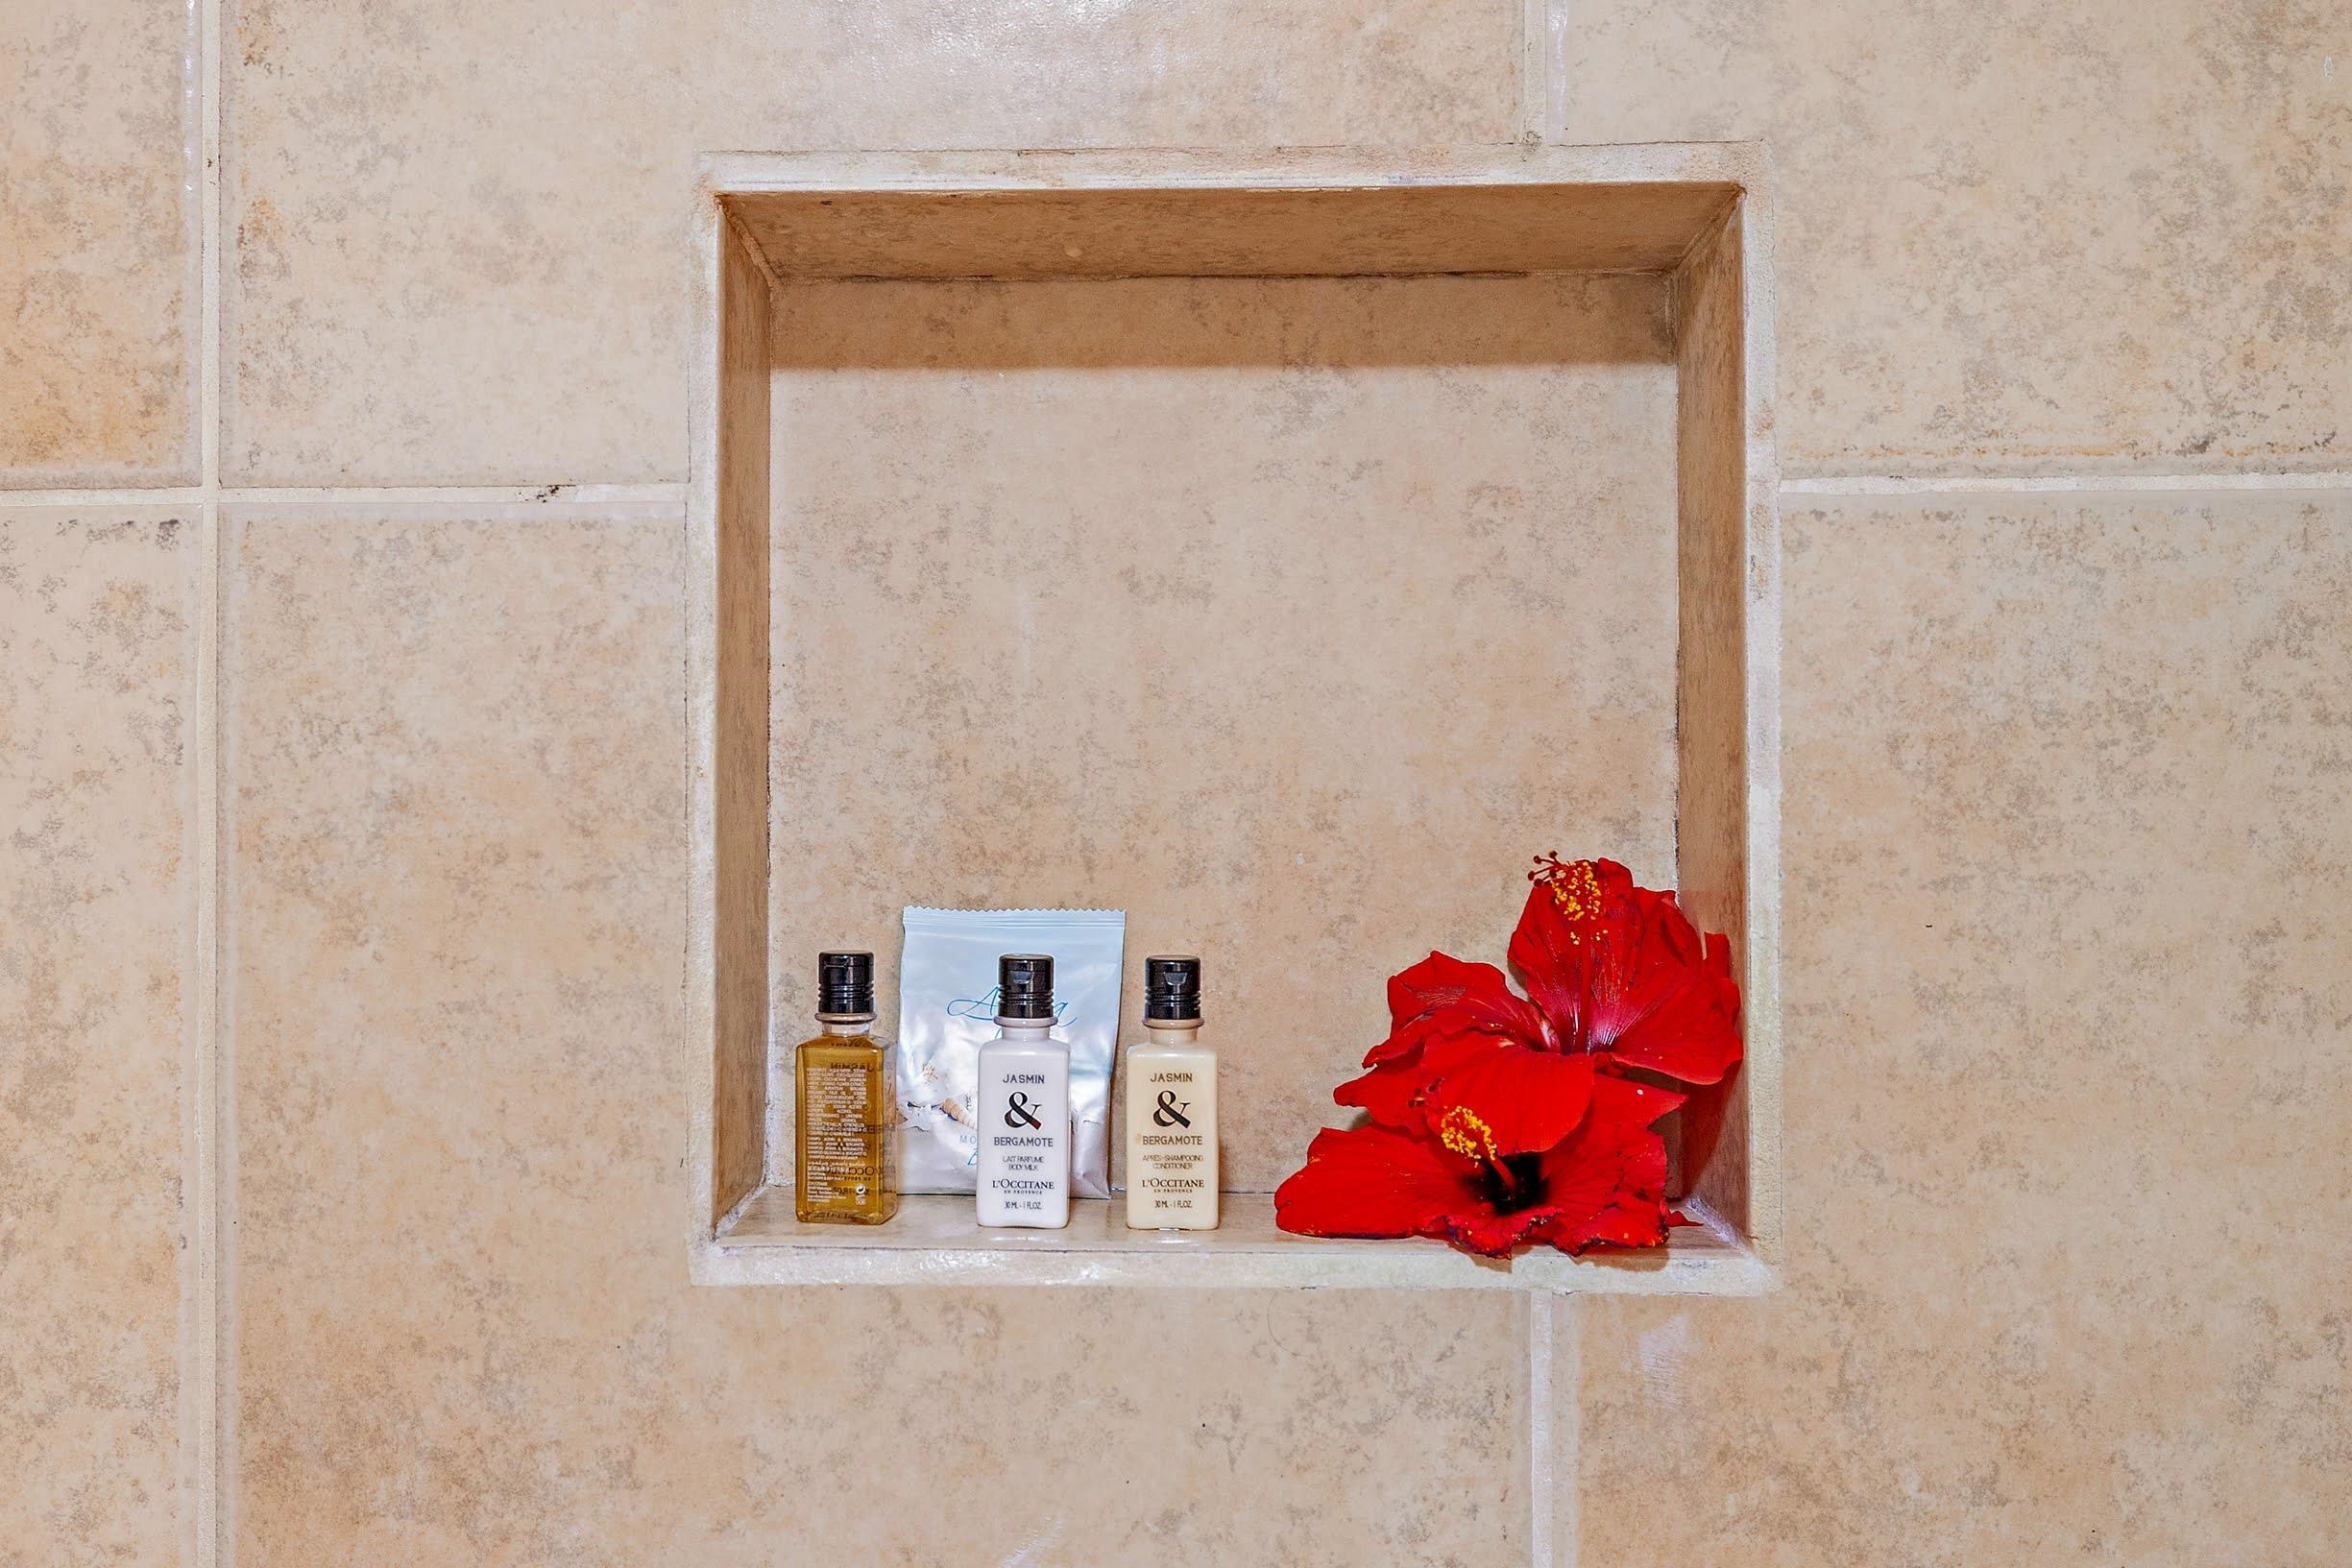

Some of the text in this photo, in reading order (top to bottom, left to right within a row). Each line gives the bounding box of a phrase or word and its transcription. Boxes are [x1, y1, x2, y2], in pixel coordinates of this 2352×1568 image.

[1003, 1073, 1045, 1084] JASMIN
[1150, 1073, 1193, 1083] JASMIN
[1004, 1091, 1042, 1130] &
[1152, 1090, 1191, 1129] &
[994, 1137, 1054, 1147] BERGAMOTE
[1142, 1136, 1202, 1146] BERGAMOTE
[992, 1178, 1055, 1190] L'OCCITANE
[1142, 1177, 1205, 1188] L'OCCITANE
